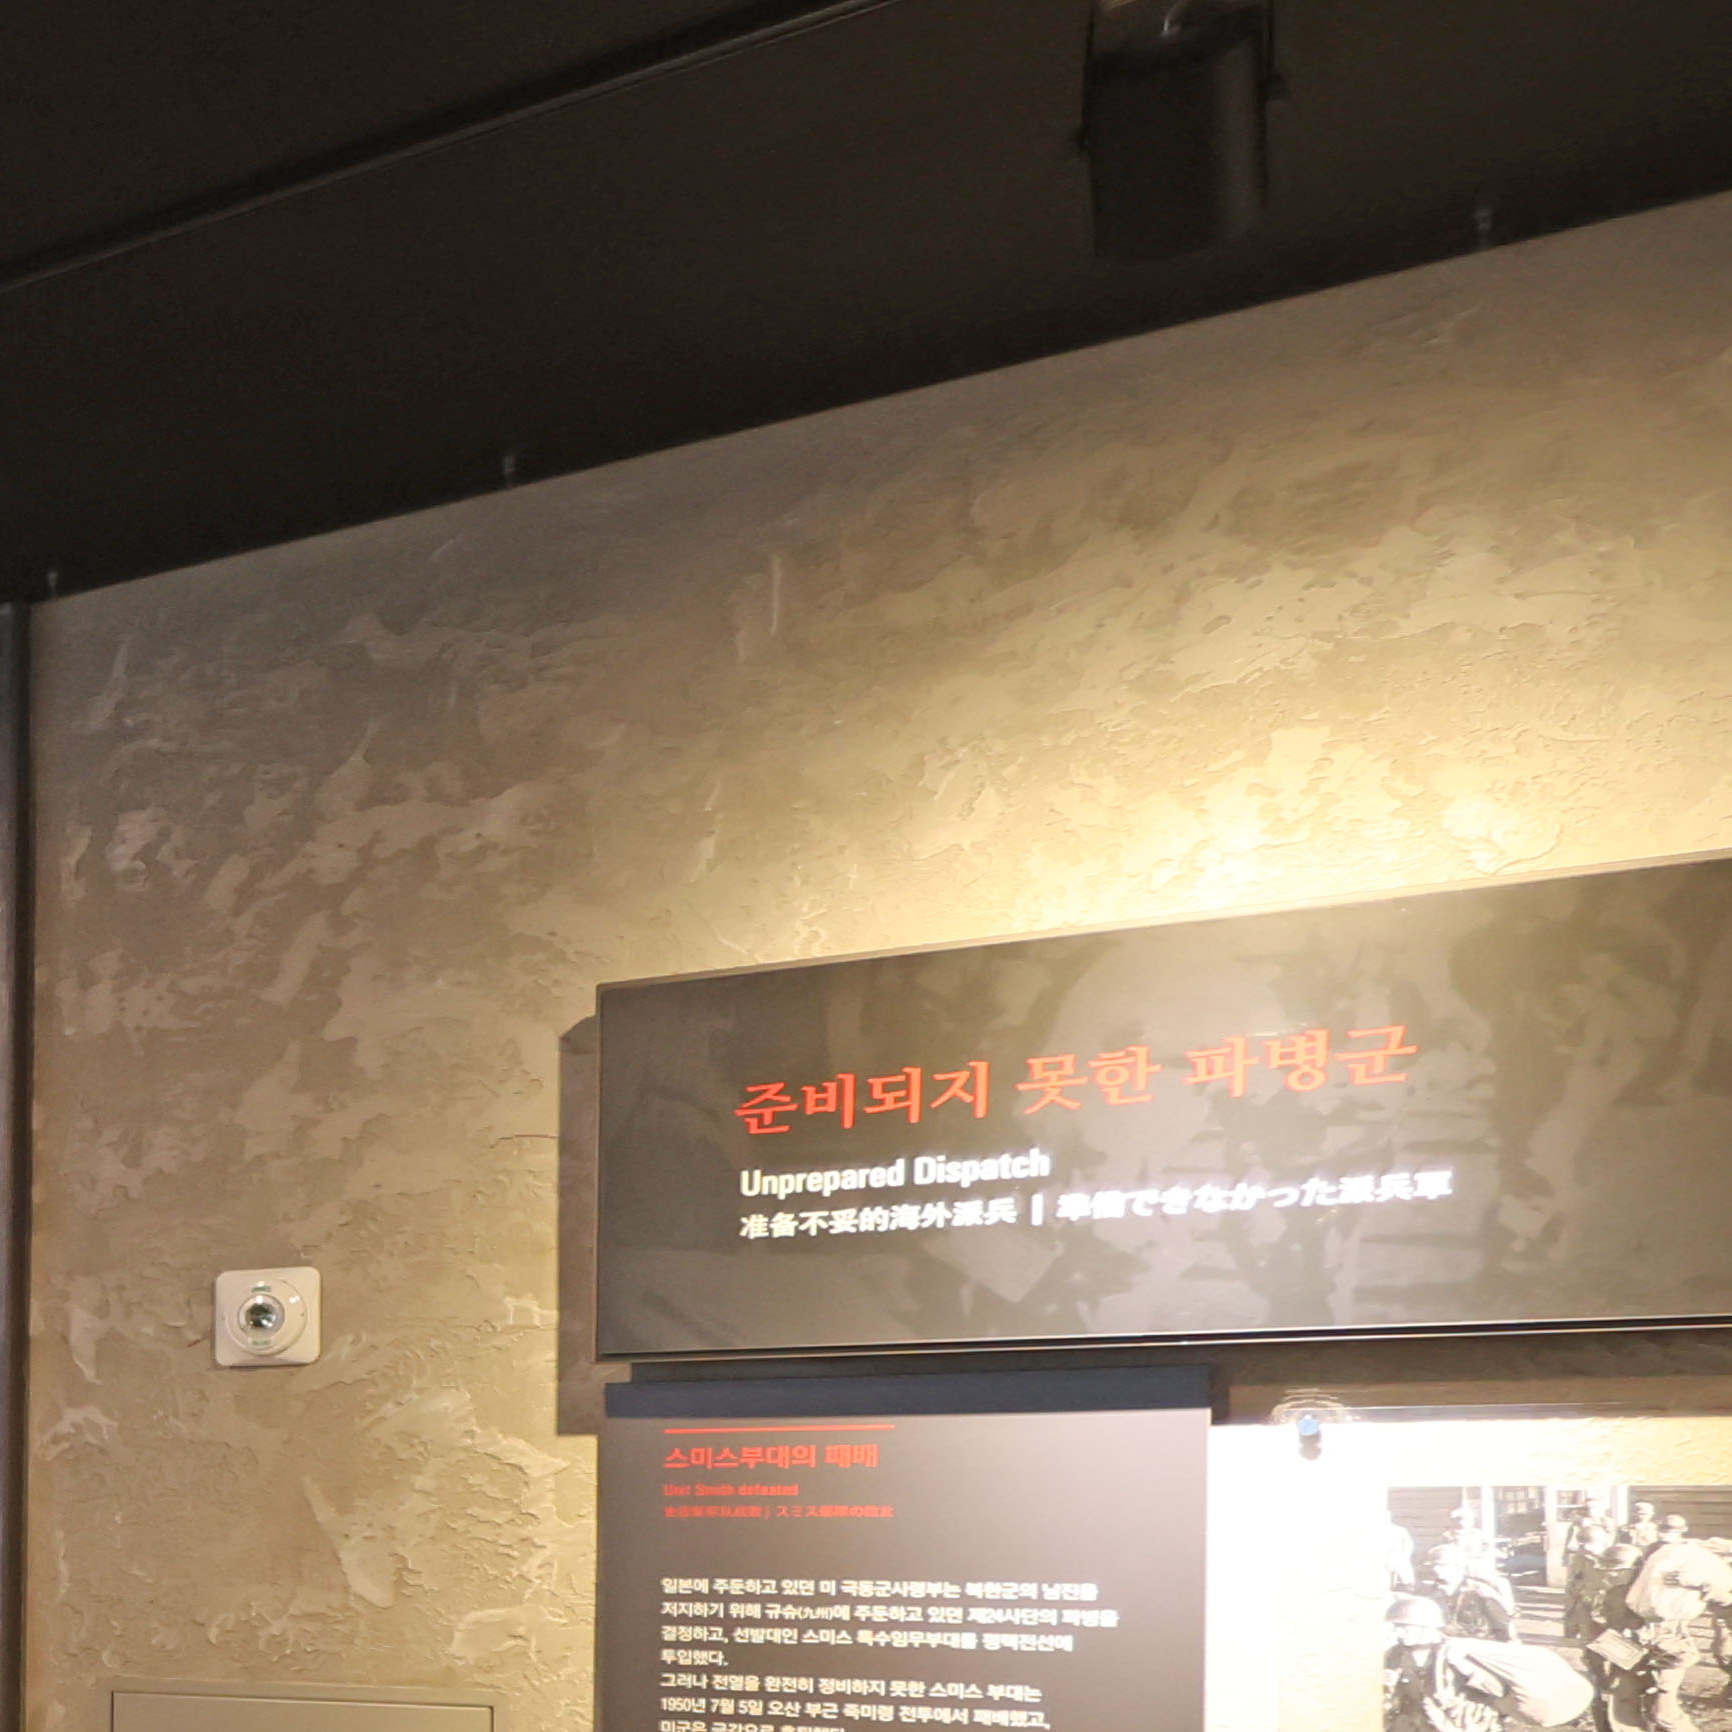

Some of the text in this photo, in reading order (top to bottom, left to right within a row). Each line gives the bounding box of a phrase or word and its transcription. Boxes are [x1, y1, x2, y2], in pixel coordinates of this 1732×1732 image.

[734, 1024, 1419, 1135] 준비되지 못한 파병군
[740, 1147, 1050, 1200] Unprepared Dispatch
[664, 1443, 880, 1470] 스미스부대의 패배
[694, 1483, 736, 1496] Smith
[661, 1578, 709, 1595] 일본에
[712, 1578, 778, 1596] 주둔하고
[780, 1579, 815, 1597] 있던
[819, 1579, 837, 1597] 미
[660, 1602, 724, 1619] 저지하기
[729, 1602, 762, 1620] 위해
[854, 1605, 924, 1623] 주둔하고
[927, 1606, 964, 1624] 있던
[660, 1625, 729, 1644] 결정하고,
[732, 1627, 798, 1645] 선발대인
[801, 1628, 854, 1646] 스미스
[660, 1648, 729, 1667] 투입했다.
[660, 1673, 709, 1690] 그러나
[764, 1676, 814, 1694] 완전히
[818, 1677, 886, 1696] 정비하지
[889, 1679, 926, 1698] 못한
[929, 1682, 984, 1699] 스미스
[986, 1683, 1043, 1703] 부대는
[660, 1698, 706, 1714] 1950년
[710, 1699, 735, 1715] 7월
[738, 1700, 764, 1716] 5일
[767, 1701, 802, 1718] 오산
[805, 1702, 838, 1719] 부근
[898, 1705, 969, 1725] 전투에서
